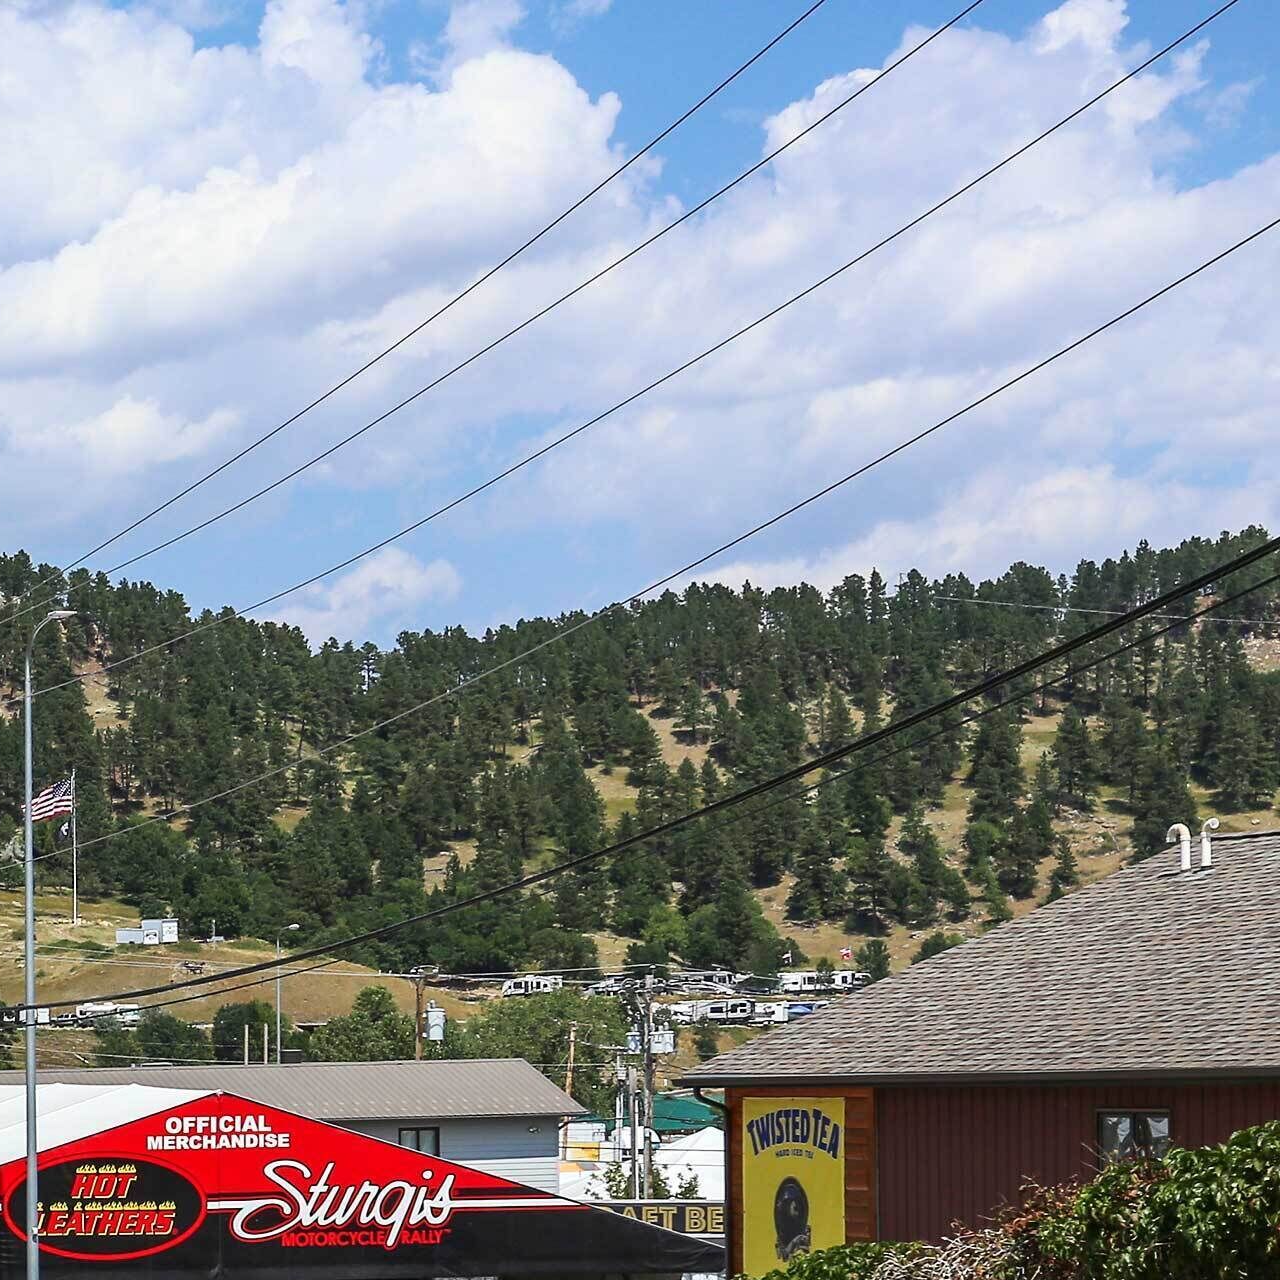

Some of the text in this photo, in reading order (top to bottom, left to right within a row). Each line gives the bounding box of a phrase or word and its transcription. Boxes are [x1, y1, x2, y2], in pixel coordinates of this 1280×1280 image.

[165, 1115, 272, 1134] OFFICIAL
[746, 1108, 842, 1159] TWISTED TEA
[146, 1133, 290, 1151] MERCHANDISE
[70, 1173, 138, 1200] HOT
[233, 1159, 455, 1247] Sturgis
[37, 1210, 177, 1236] LEATHERS
[281, 1229, 385, 1247] MOTORCYCLE
